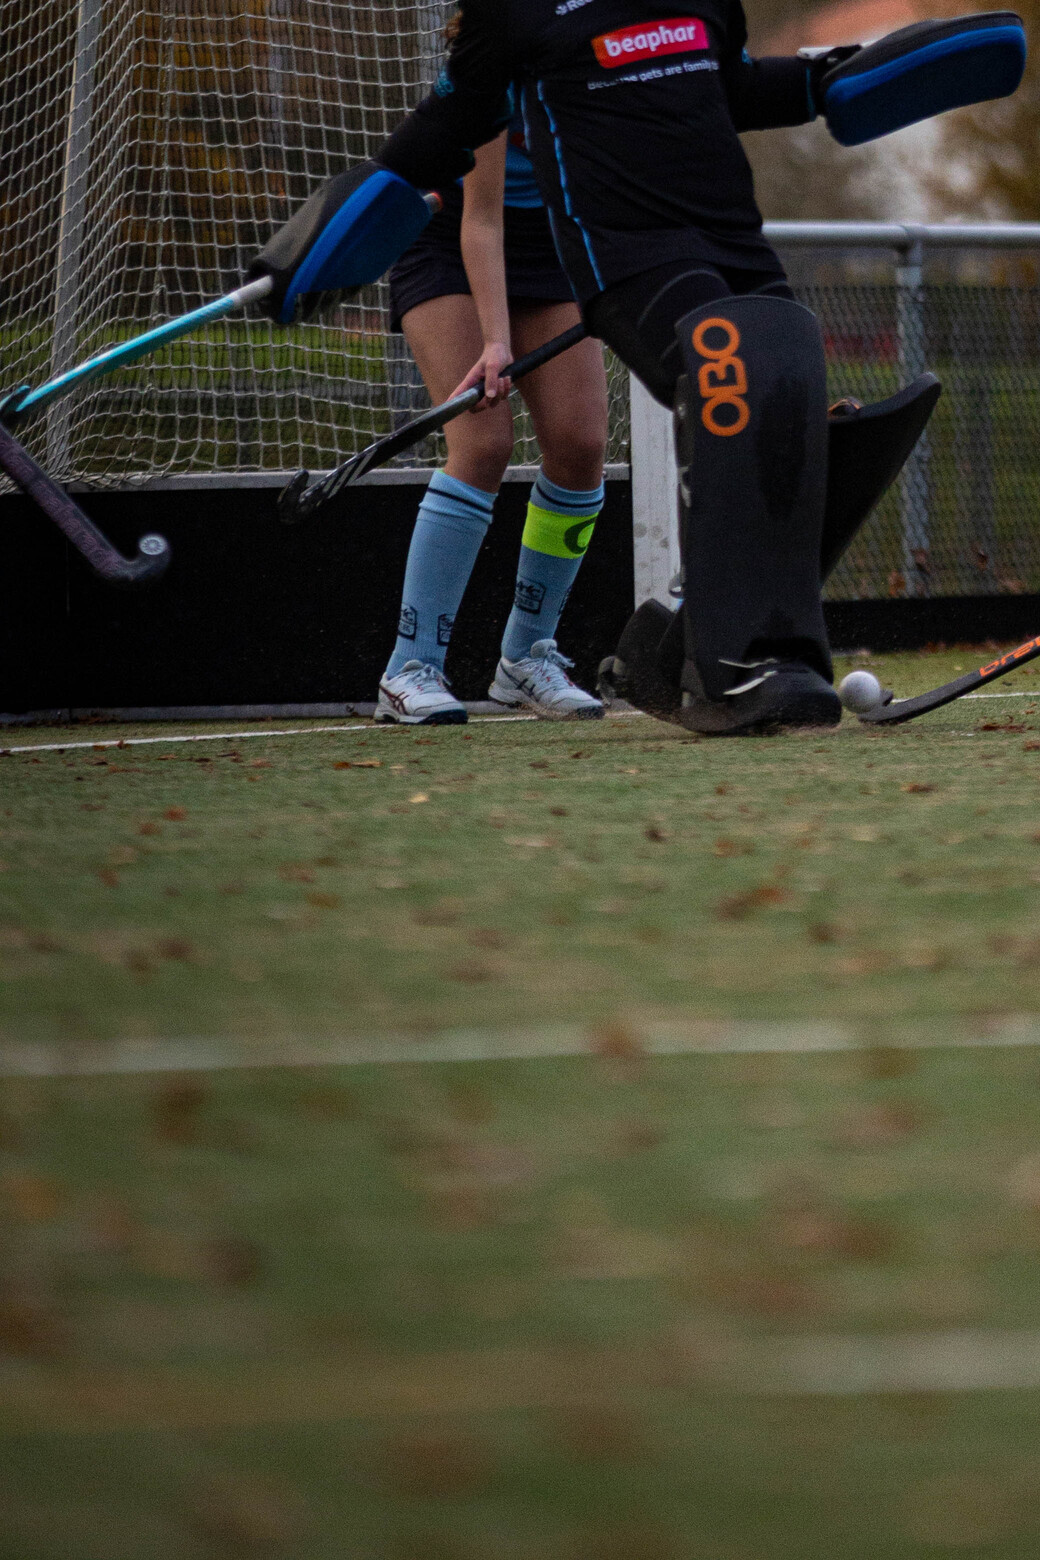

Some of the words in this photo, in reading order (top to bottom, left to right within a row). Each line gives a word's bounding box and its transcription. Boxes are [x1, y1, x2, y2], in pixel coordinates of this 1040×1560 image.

[604, 26, 696, 57] beaphar
[639, 68, 664, 82] pets
[665, 65, 682, 76] are
[692, 317, 750, 437] OBO
